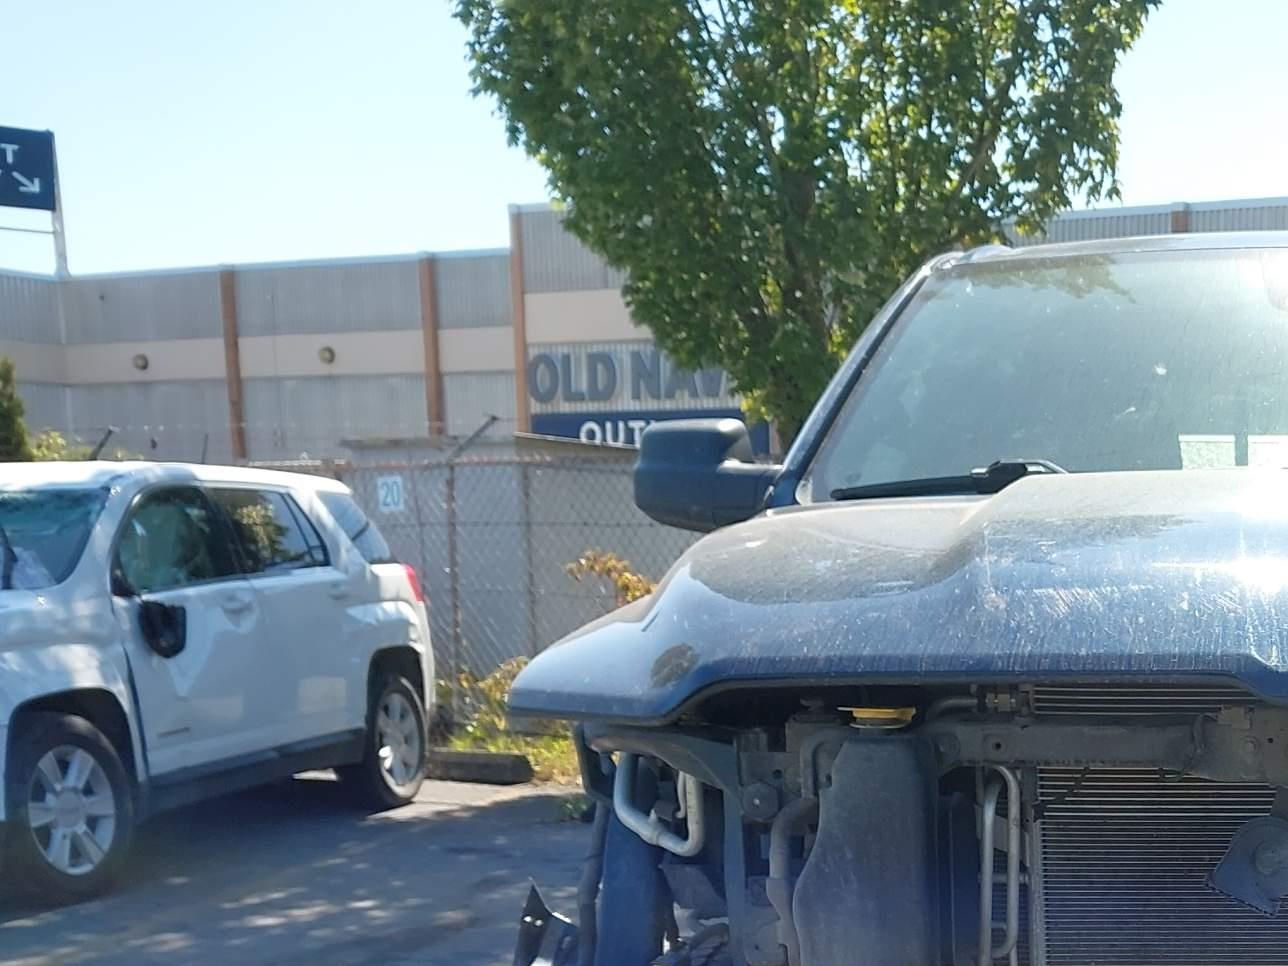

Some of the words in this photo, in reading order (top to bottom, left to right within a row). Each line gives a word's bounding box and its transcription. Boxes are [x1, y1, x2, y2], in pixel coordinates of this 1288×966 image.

[528, 352, 617, 402] OLD
[630, 349, 738, 400] NAV
[579, 419, 656, 448] OUT
[380, 480, 401, 507] 20
